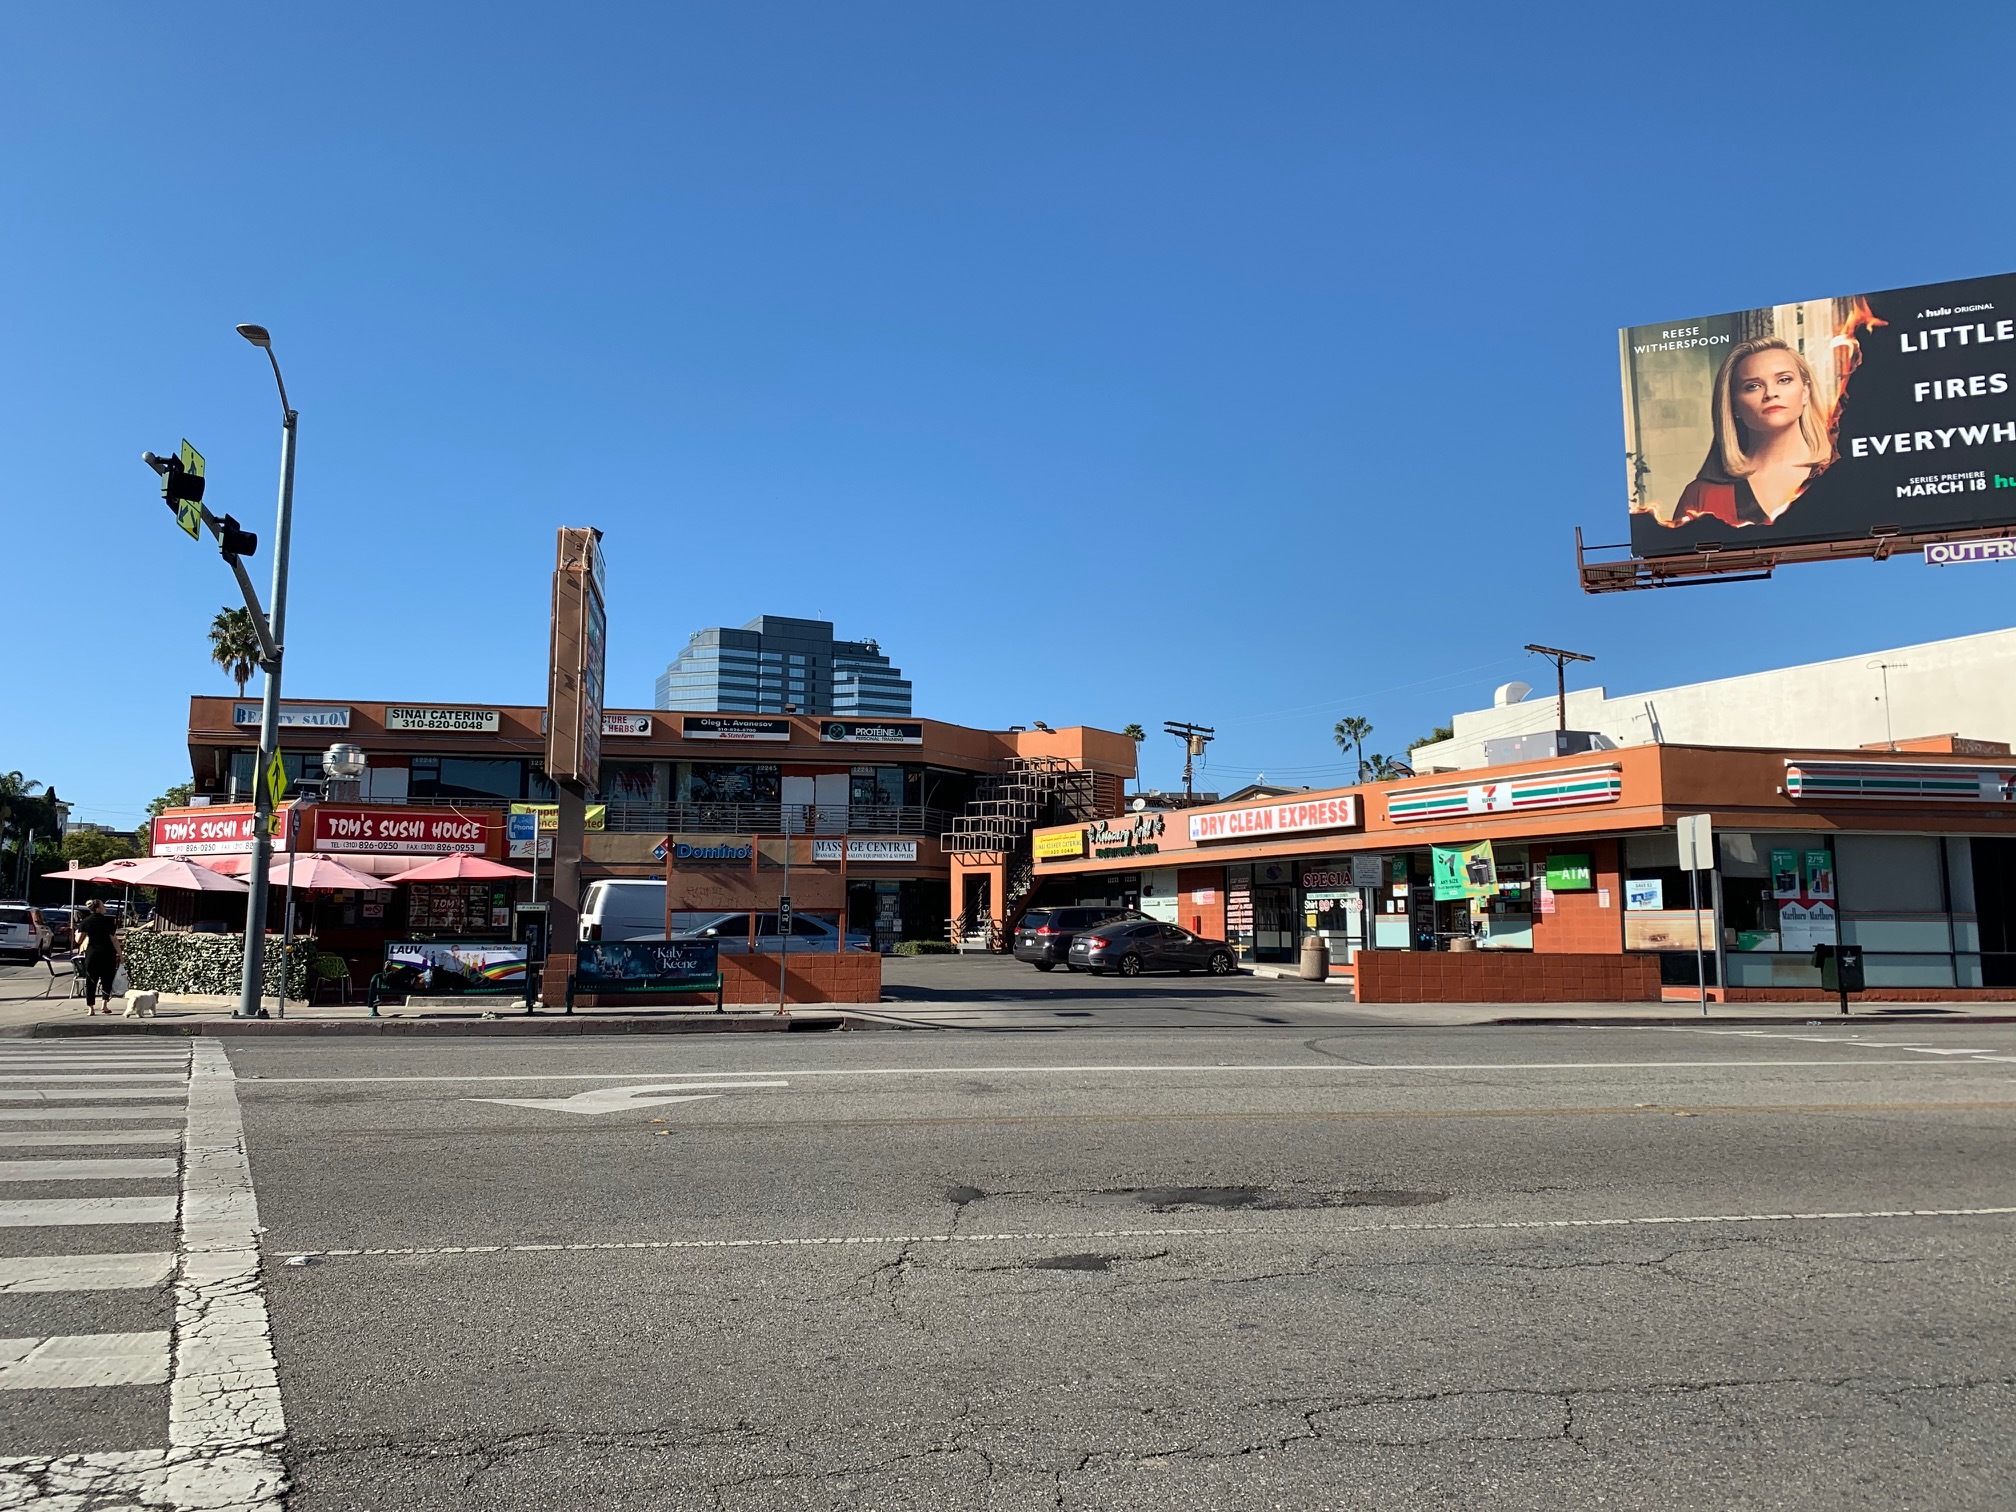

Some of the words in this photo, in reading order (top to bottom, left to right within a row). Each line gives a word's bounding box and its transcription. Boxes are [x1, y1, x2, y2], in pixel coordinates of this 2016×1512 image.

[1925, 307, 1951, 318] hulu
[1954, 302, 1995, 314] ORIGINAL
[1662, 326, 1700, 339] REESE
[1900, 319, 2015, 353] LITTLE
[1634, 334, 1730, 354] WITHERSPOON
[1914, 372, 2009, 402] FIRES
[1909, 475, 1939, 485] SERIES
[1941, 470, 1986, 481] PREMIERE
[1896, 481, 1964, 498] MARCH
[1970, 478, 1987, 491] 18
[302, 710, 348, 726] SALON
[392, 709, 426, 720] SINAI
[430, 710, 494, 722] CATERING
[402, 719, 483, 730] 310-820-0048
[608, 725, 635, 733] HERBS
[701, 719, 721, 727] Oleg
[732, 720, 773, 728] Avanesov
[1201, 815, 1226, 836] DRY
[1229, 809, 1273, 833] CLEAN
[1278, 799, 1349, 828] EXPRESS
[164, 817, 197, 841] TOM'S
[200, 820, 238, 839] SUSHI
[328, 813, 373, 837] TOM'S
[379, 820, 425, 838] SUSHI
[431, 821, 480, 839] HOUSE
[185, 843, 216, 852] 826-0250
[343, 841, 358, 849] (310)
[358, 841, 399, 850] 826-0250
[436, 844, 475, 852] 826-0253
[866, 841, 914, 852] CENTRAL
[1561, 867, 1590, 880] ATM
[1782, 907, 1807, 920] Marlboro
[1809, 907, 1834, 920] Marlboro
[389, 945, 423, 955] LAUV
[663, 958, 698, 969] Keene
